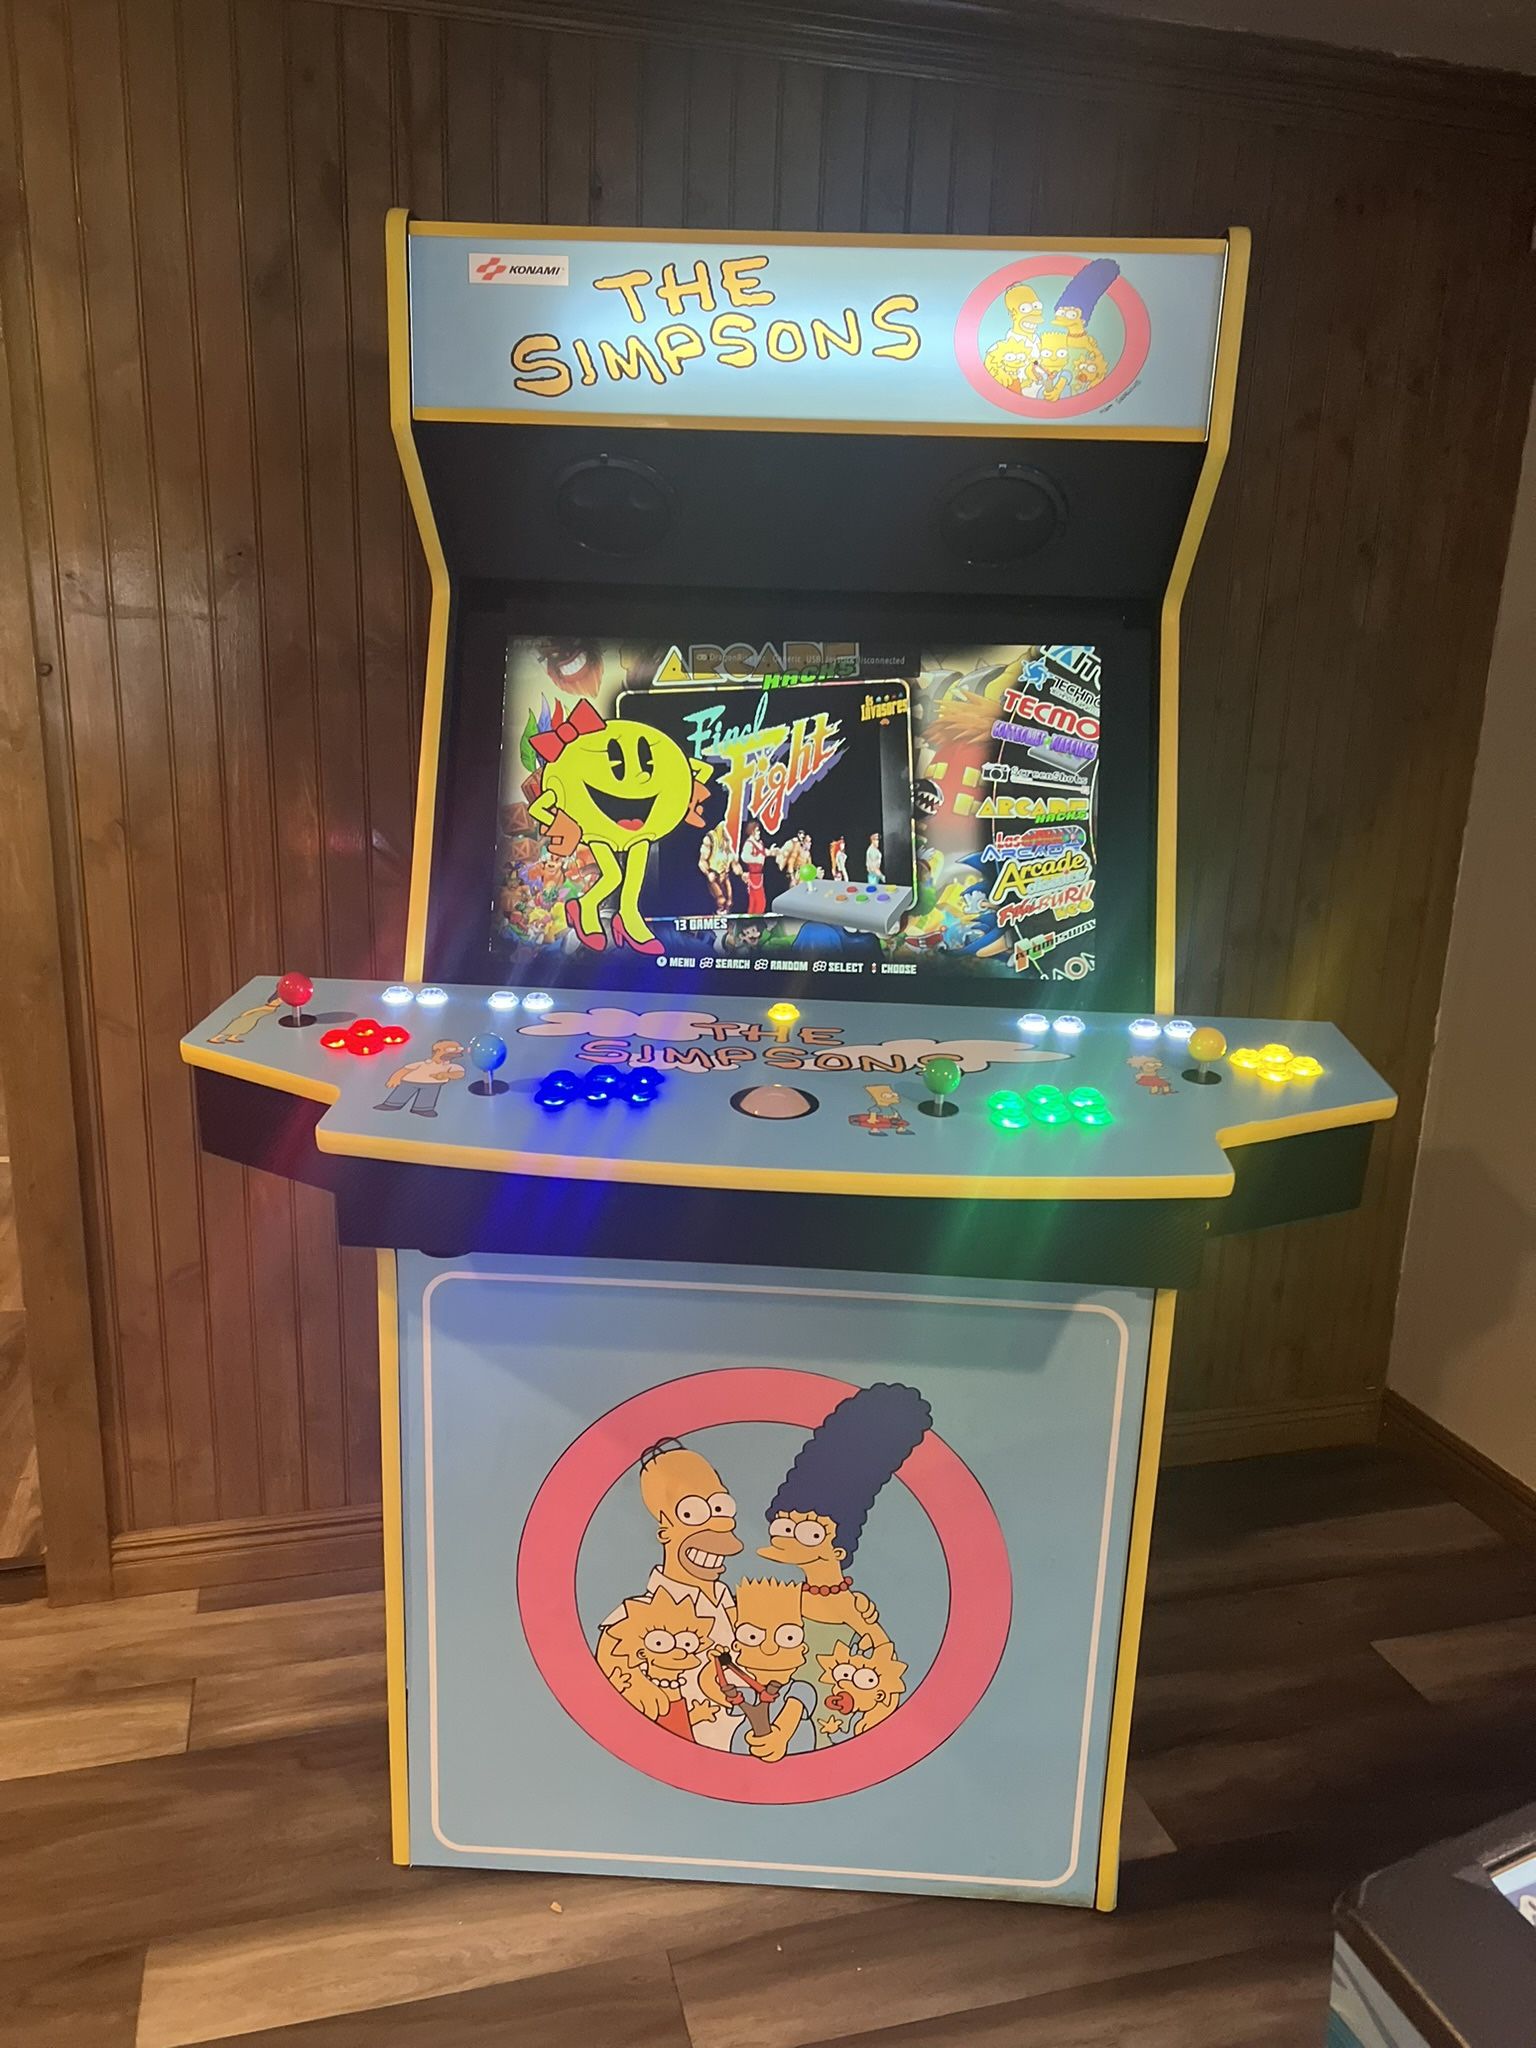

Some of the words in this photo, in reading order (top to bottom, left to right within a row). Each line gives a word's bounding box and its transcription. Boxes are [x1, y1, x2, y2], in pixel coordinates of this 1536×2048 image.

[508, 265, 561, 276] KONAMI
[593, 256, 776, 324] THE
[511, 294, 921, 397] SIMPSONS
[652, 641, 860, 686] ARCADE
[1004, 688, 1100, 740] TECMO
[701, 712, 847, 858] Fight
[976, 796, 1090, 818] ARCADE
[991, 850, 1088, 903] Arcade
[689, 918, 728, 931] GAMES
[669, 957, 696, 968] MENU
[715, 959, 751, 970] SEARCH
[770, 960, 808, 972] RANDOM
[828, 962, 864, 974] SELECT
[881, 963, 917, 975] CHOOSE
[689, 1021, 845, 1046] THE
